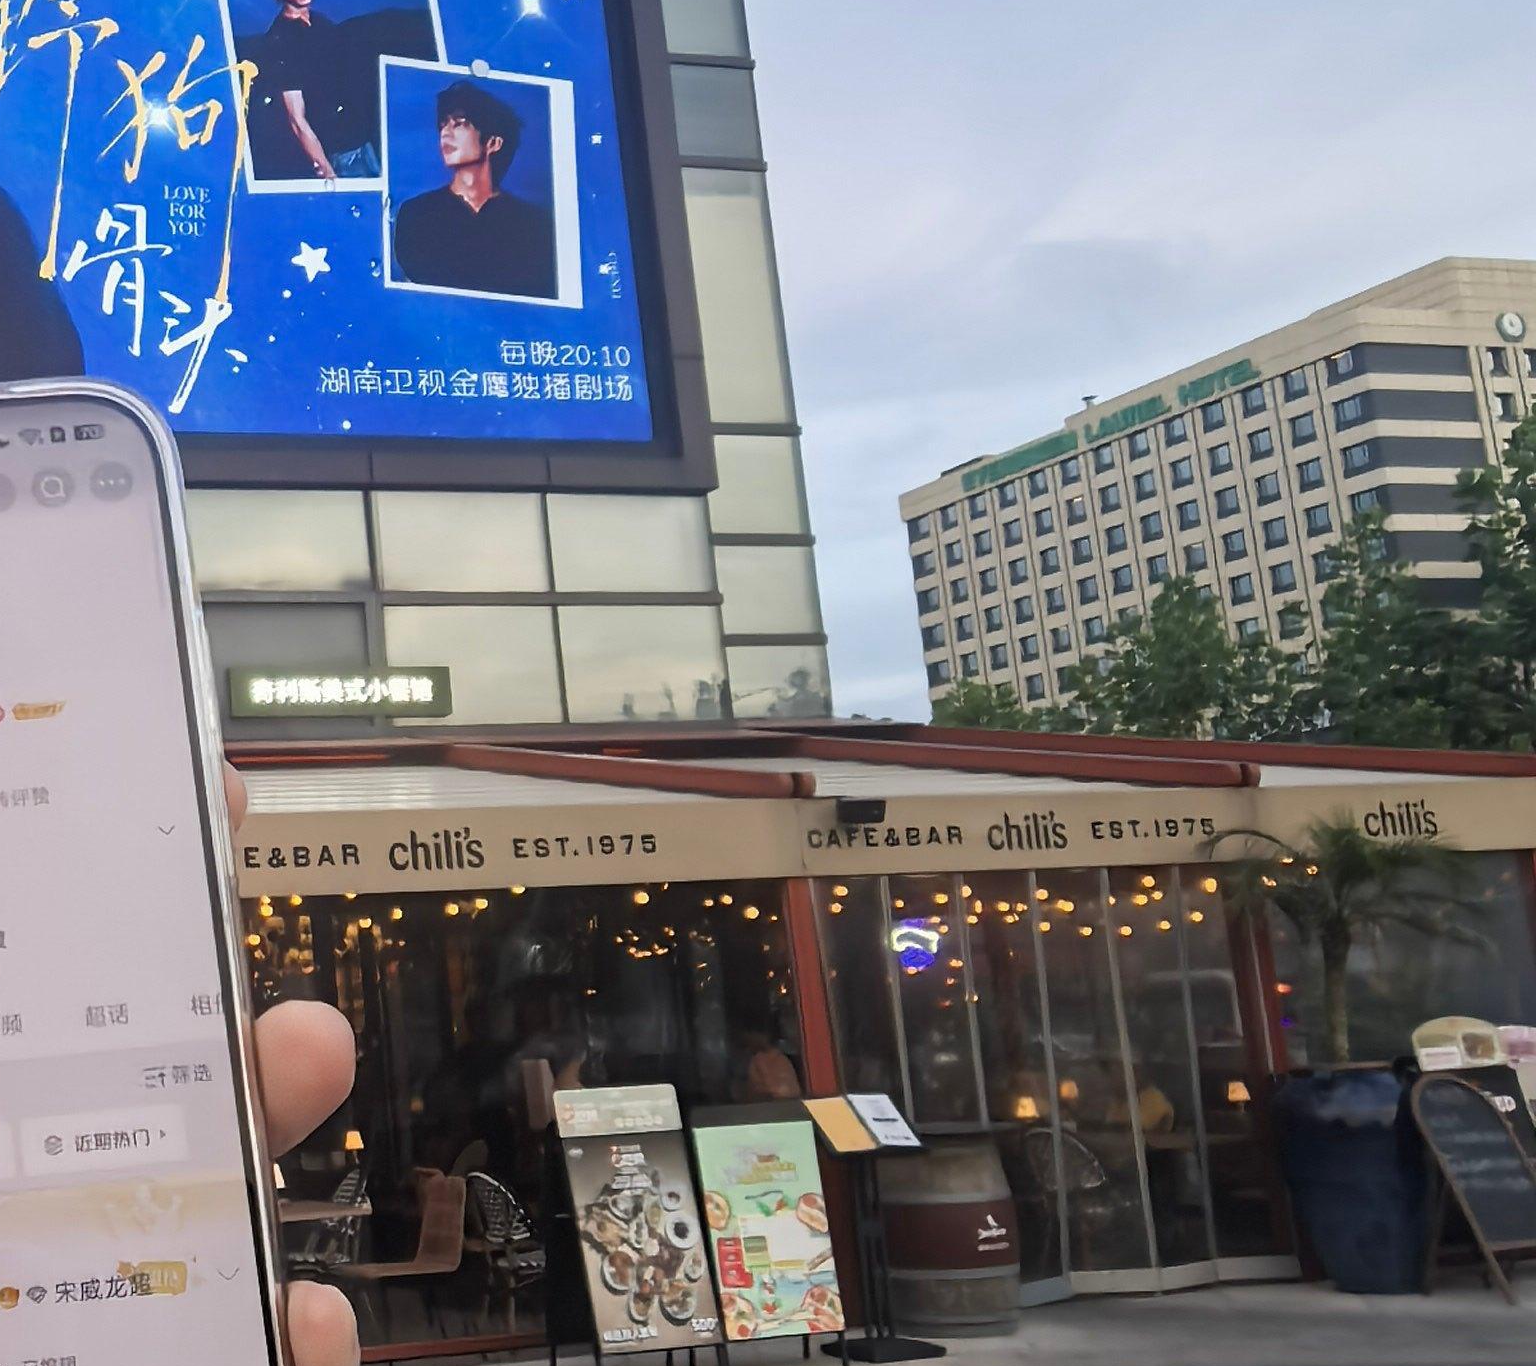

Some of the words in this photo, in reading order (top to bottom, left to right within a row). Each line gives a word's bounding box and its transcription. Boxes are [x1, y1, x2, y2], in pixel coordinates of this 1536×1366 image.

[164, 185, 211, 203] LOVE
[169, 202, 206, 220] FOR
[168, 219, 206, 237] YOU
[500, 340, 631, 368] 每晚20:10
[320, 366, 633, 402] 湖南卫视金鹰独播剧场
[807, 825, 963, 849] CAFE&BAR
[987, 809, 1069, 852] chili's
[1091, 816, 1216, 840] EST.1975
[1364, 799, 1439, 840] chili's
[244, 843, 361, 871] E&BAR
[388, 827, 486, 873] chili's
[512, 834, 658, 859] EST.1975
